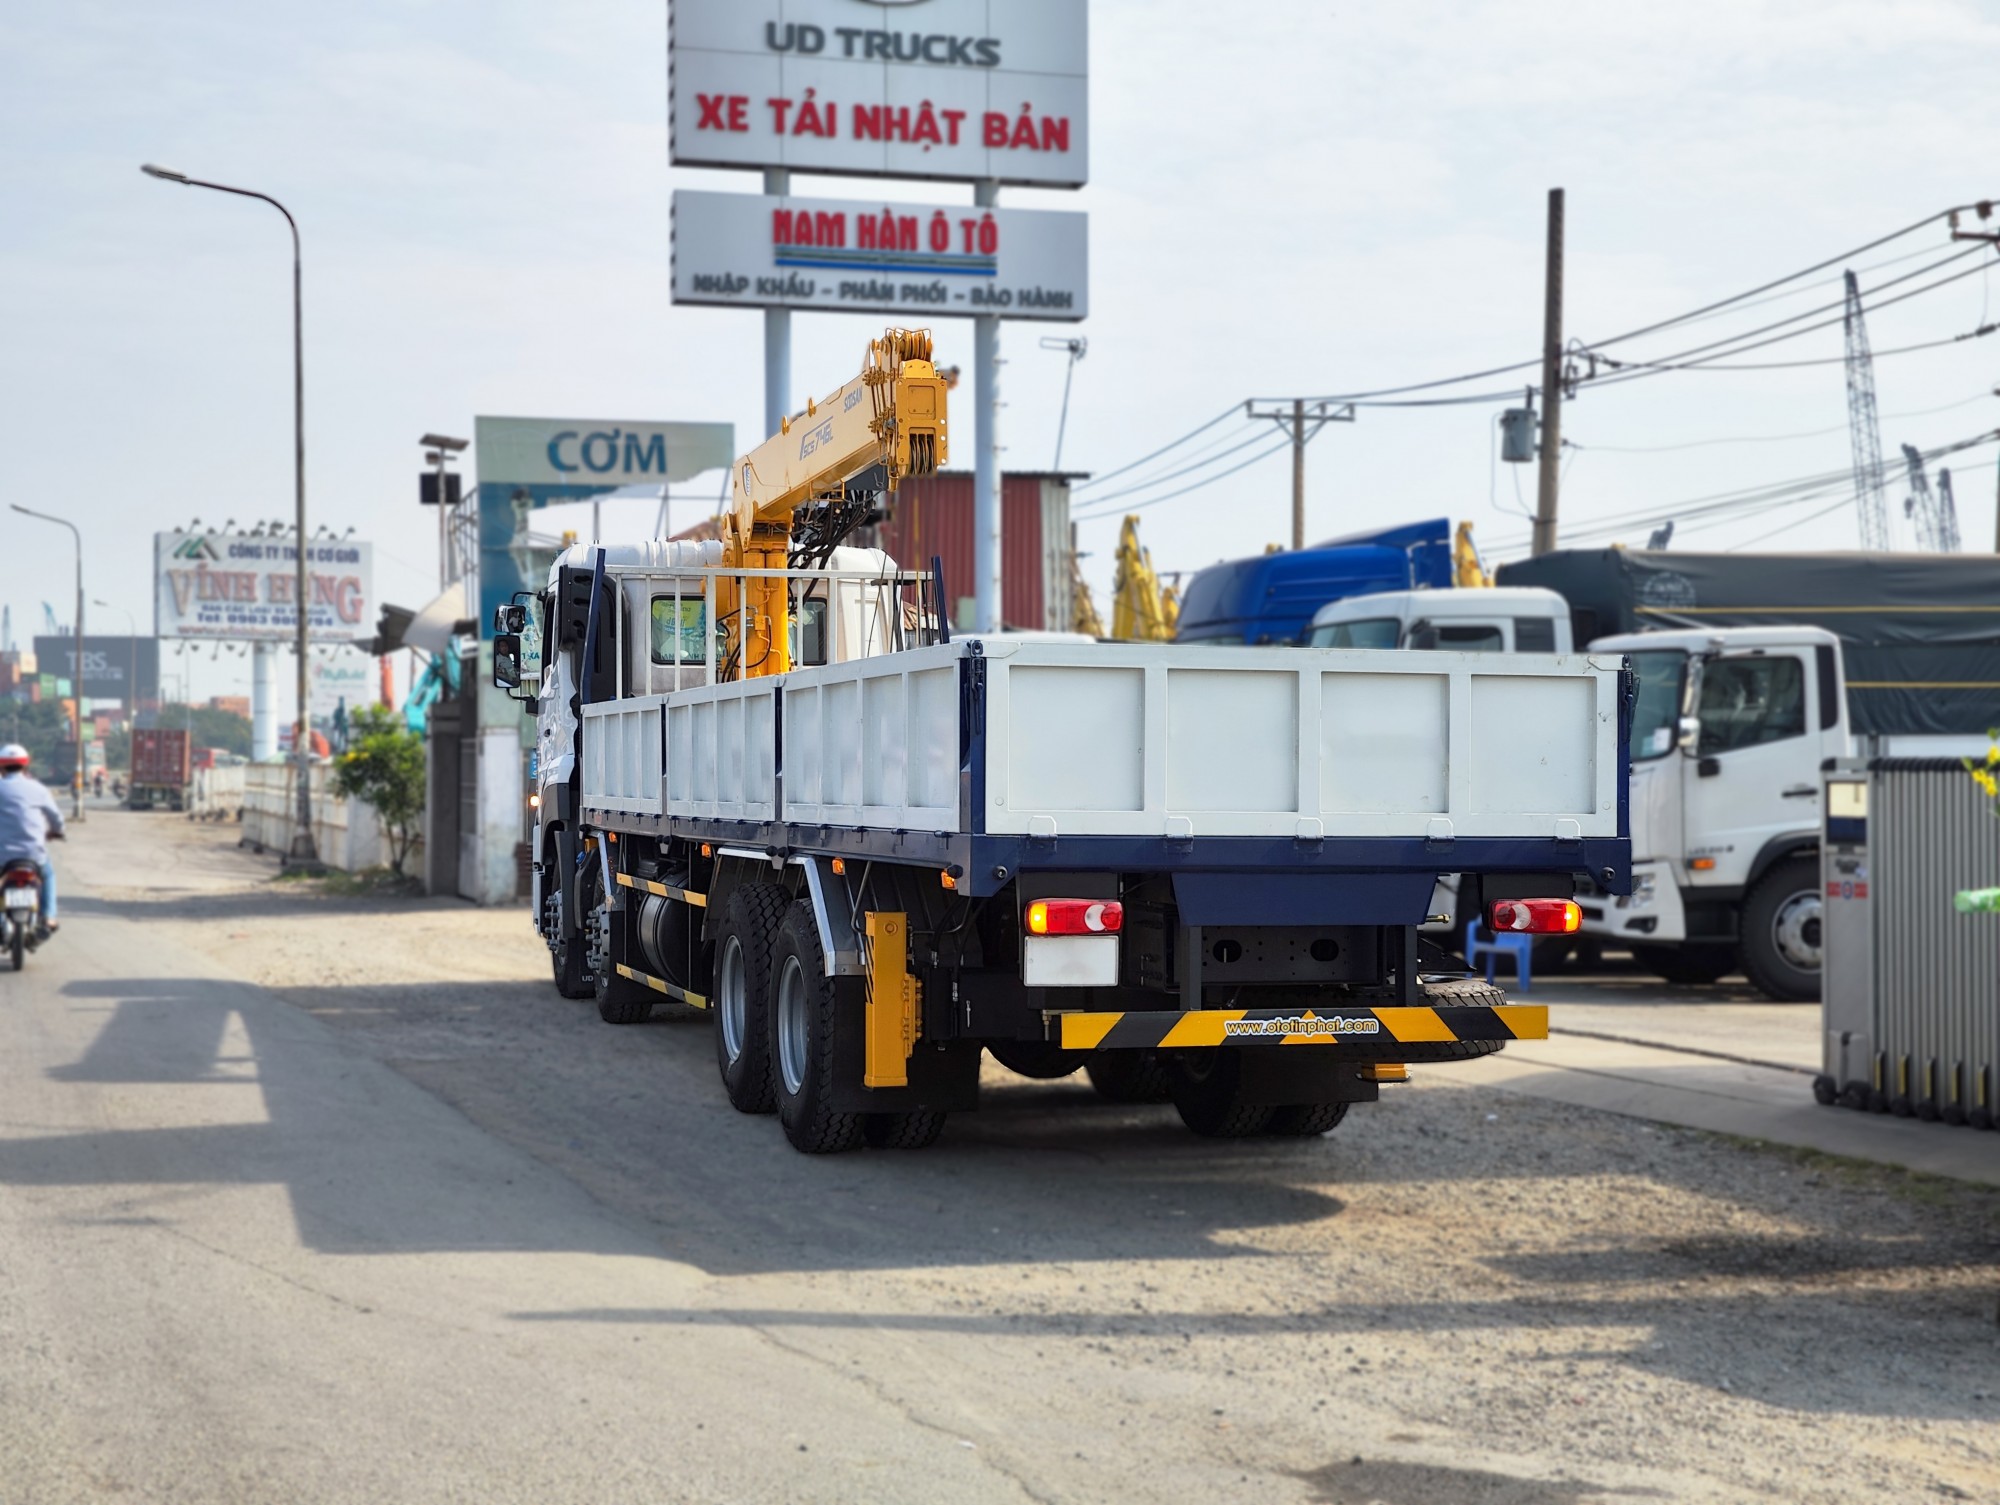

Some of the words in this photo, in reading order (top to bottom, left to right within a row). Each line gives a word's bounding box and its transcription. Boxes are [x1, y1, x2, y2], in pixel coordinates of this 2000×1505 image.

[765, 21, 825, 54] UD
[834, 27, 1002, 67] TRUCKS
[696, 93, 749, 132] XE
[766, 87, 836, 138] TẢI
[853, 99, 966, 152] NHẬT
[982, 102, 1069, 152] BẢN
[772, 209, 846, 248] NAM
[857, 207, 918, 252] HÀN
[929, 209, 950, 253] Ô
[959, 212, 998, 255] TÔ
[693, 272, 749, 296] NHẬP
[839, 279, 894, 301] PHÂN
[901, 279, 947, 304] PHỐI
[1018, 285, 1073, 309] HÀNH
[546, 428, 667, 474] CƠM
[265, 546, 279, 560] TY
[1225, 1018, 1377, 1035] www.ototinphat.com
